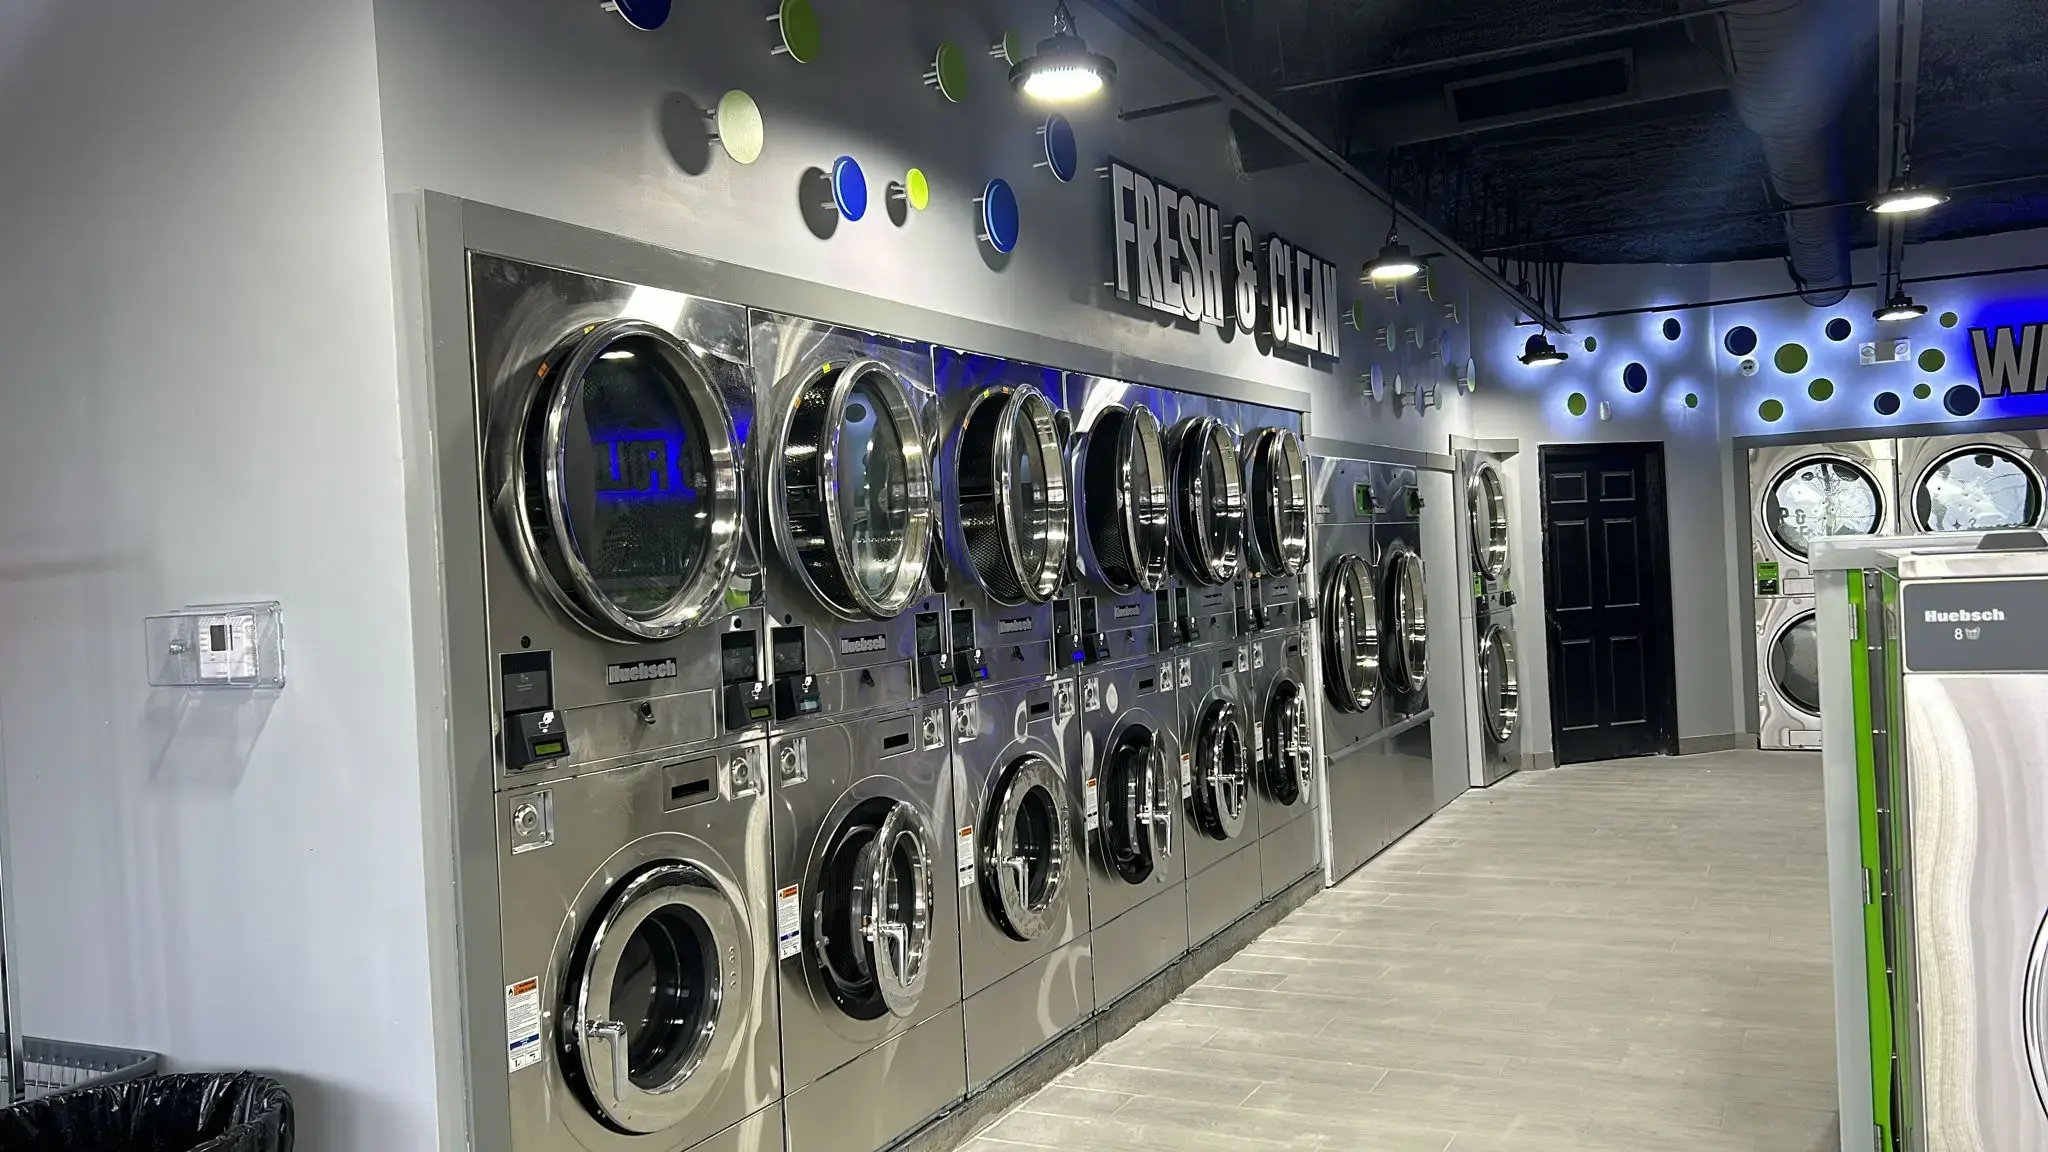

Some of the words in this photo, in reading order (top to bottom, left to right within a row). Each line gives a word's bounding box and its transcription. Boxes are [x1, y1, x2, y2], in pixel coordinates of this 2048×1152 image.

[1110, 159, 1225, 329] FRESH
[1233, 217, 1258, 334] &
[1267, 234, 1341, 360] CLEAN
[1924, 608, 2005, 623] Huebsch
[1954, 627, 1964, 640] 8
[608, 659, 677, 684] Huebsch
